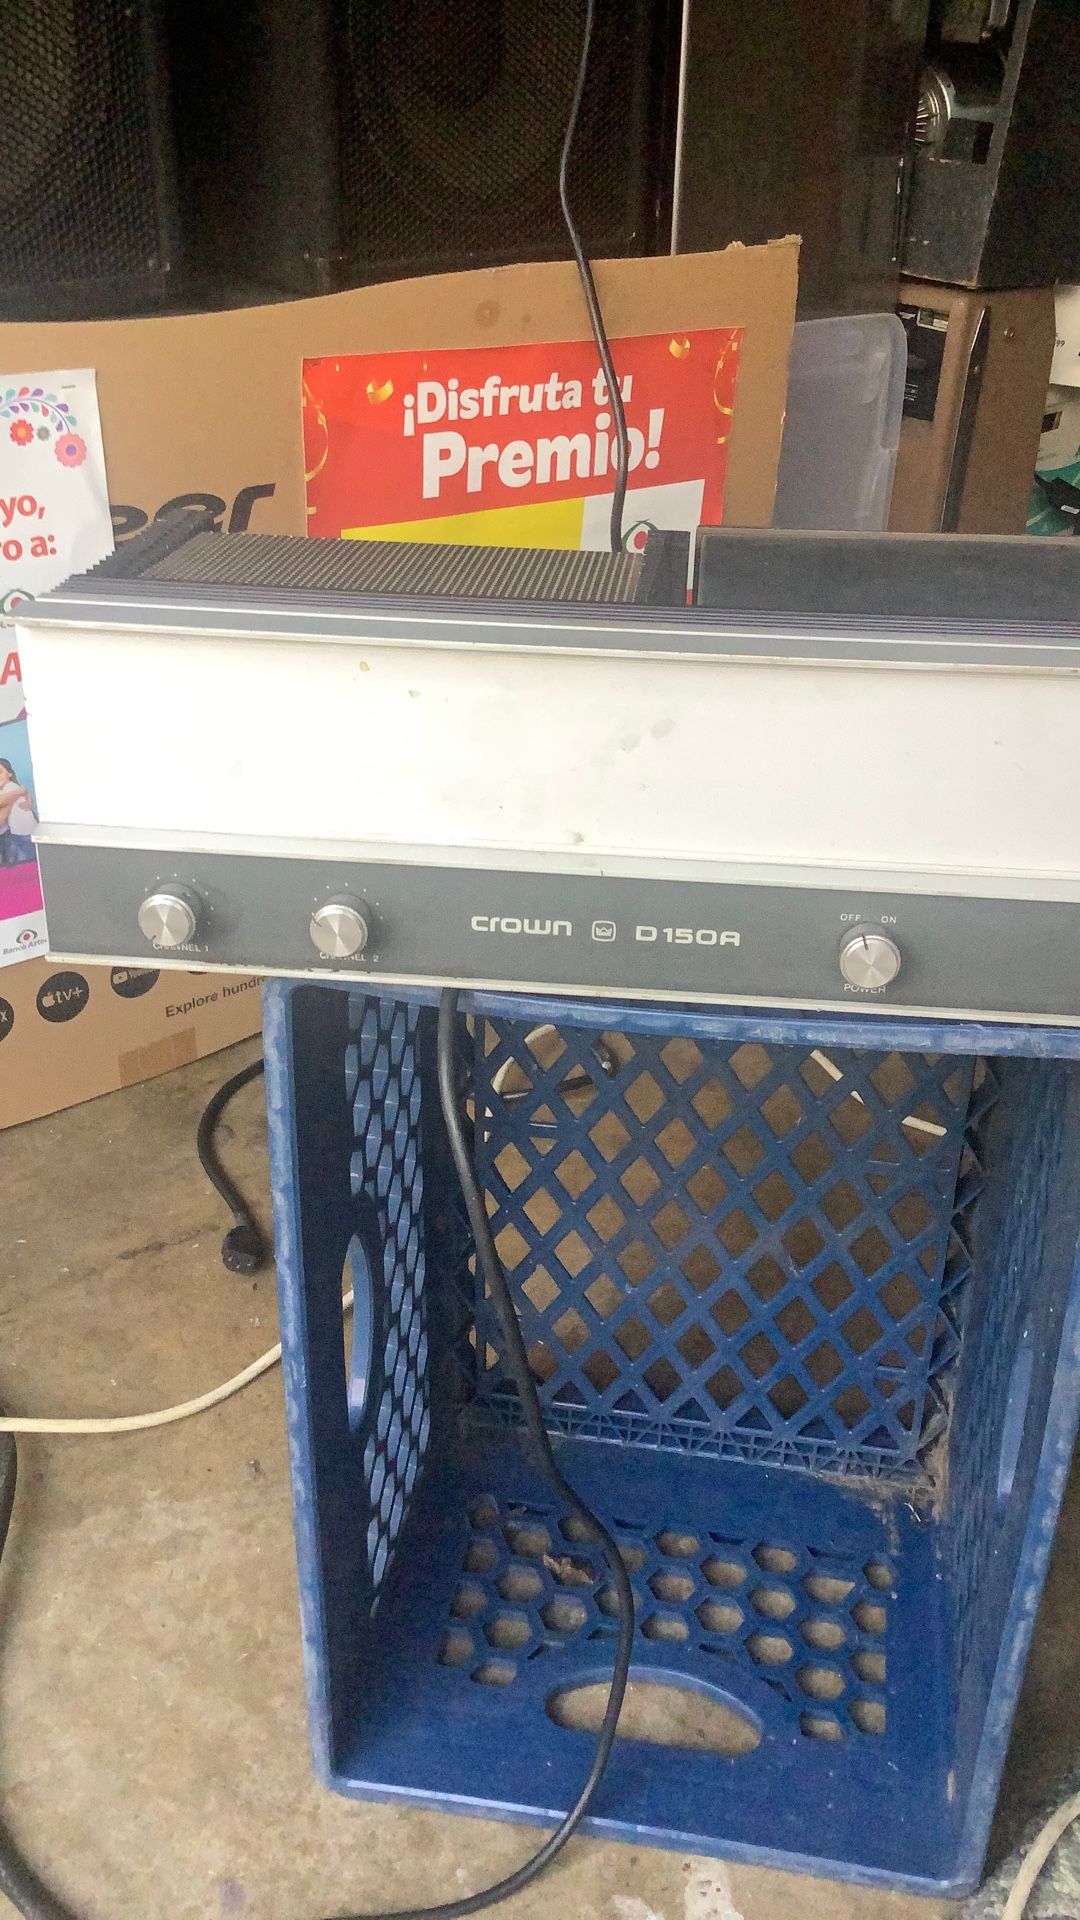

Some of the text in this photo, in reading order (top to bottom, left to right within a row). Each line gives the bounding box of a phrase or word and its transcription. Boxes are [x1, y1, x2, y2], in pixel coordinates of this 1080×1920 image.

[403, 367, 633, 437] ¡Disfruta tu
[422, 408, 665, 499] Premio!
[0, 534, 57, 561] o a:
[840, 913, 861, 922] OFF
[881, 916, 897, 924] ON
[165, 991, 219, 1017] Explore
